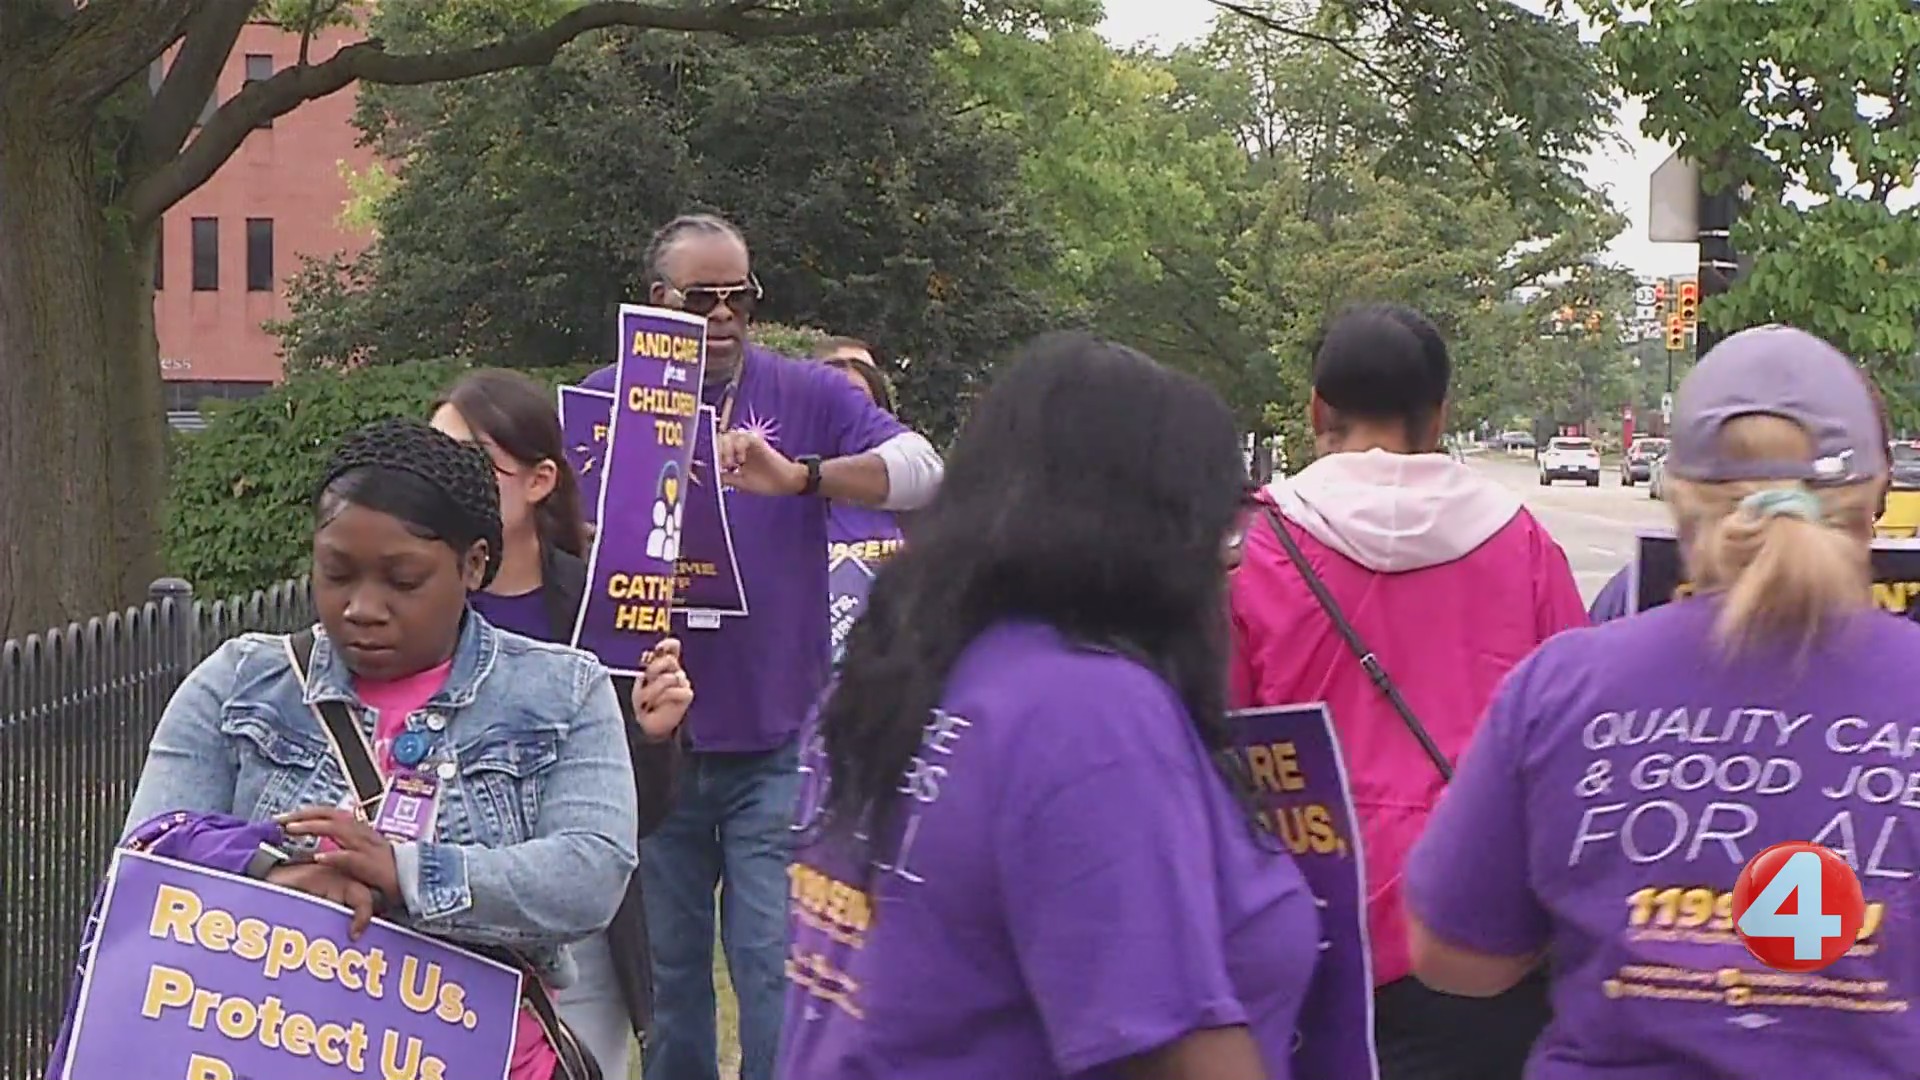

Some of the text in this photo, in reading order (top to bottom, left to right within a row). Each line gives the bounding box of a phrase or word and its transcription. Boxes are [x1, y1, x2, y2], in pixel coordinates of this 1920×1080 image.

[1638, 289, 1656, 302] 33
[632, 330, 672, 359] AND
[1582, 707, 1813, 750] QUALITY
[1575, 758, 1615, 798] &
[1630, 753, 1802, 794] GOOD
[1567, 801, 1759, 867] FOR
[149, 884, 478, 1029] Respect Us.
[141, 964, 368, 1072] Protect
